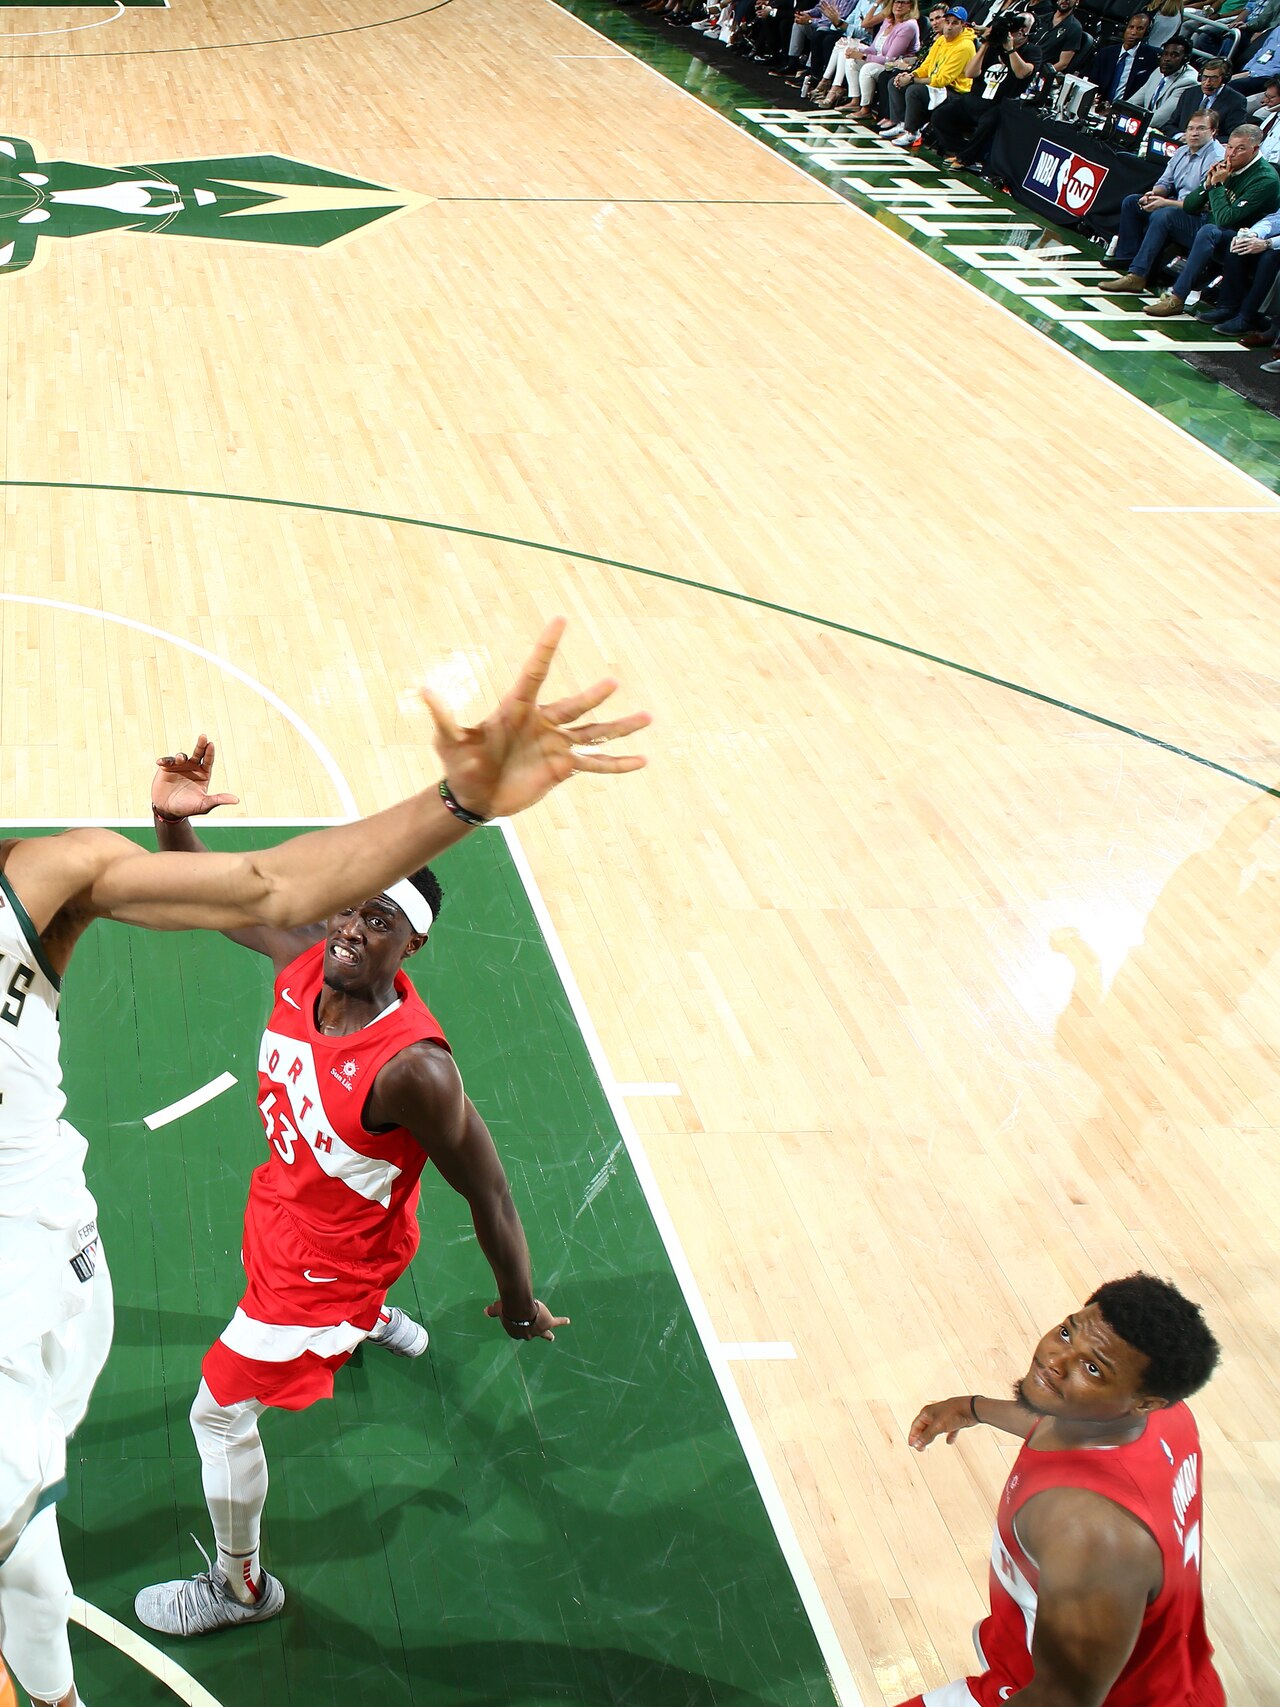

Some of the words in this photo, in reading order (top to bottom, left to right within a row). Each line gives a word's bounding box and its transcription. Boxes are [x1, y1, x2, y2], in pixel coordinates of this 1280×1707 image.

[735, 108, 940, 171] DEER
[1032, 151, 1060, 188] NBA
[841, 178, 1042, 237] THE
[942, 244, 1251, 351] FEAR
[266, 1049, 333, 1154] ORTH
[330, 1068, 343, 1081] Sun
[341, 1077, 353, 1092] Life
